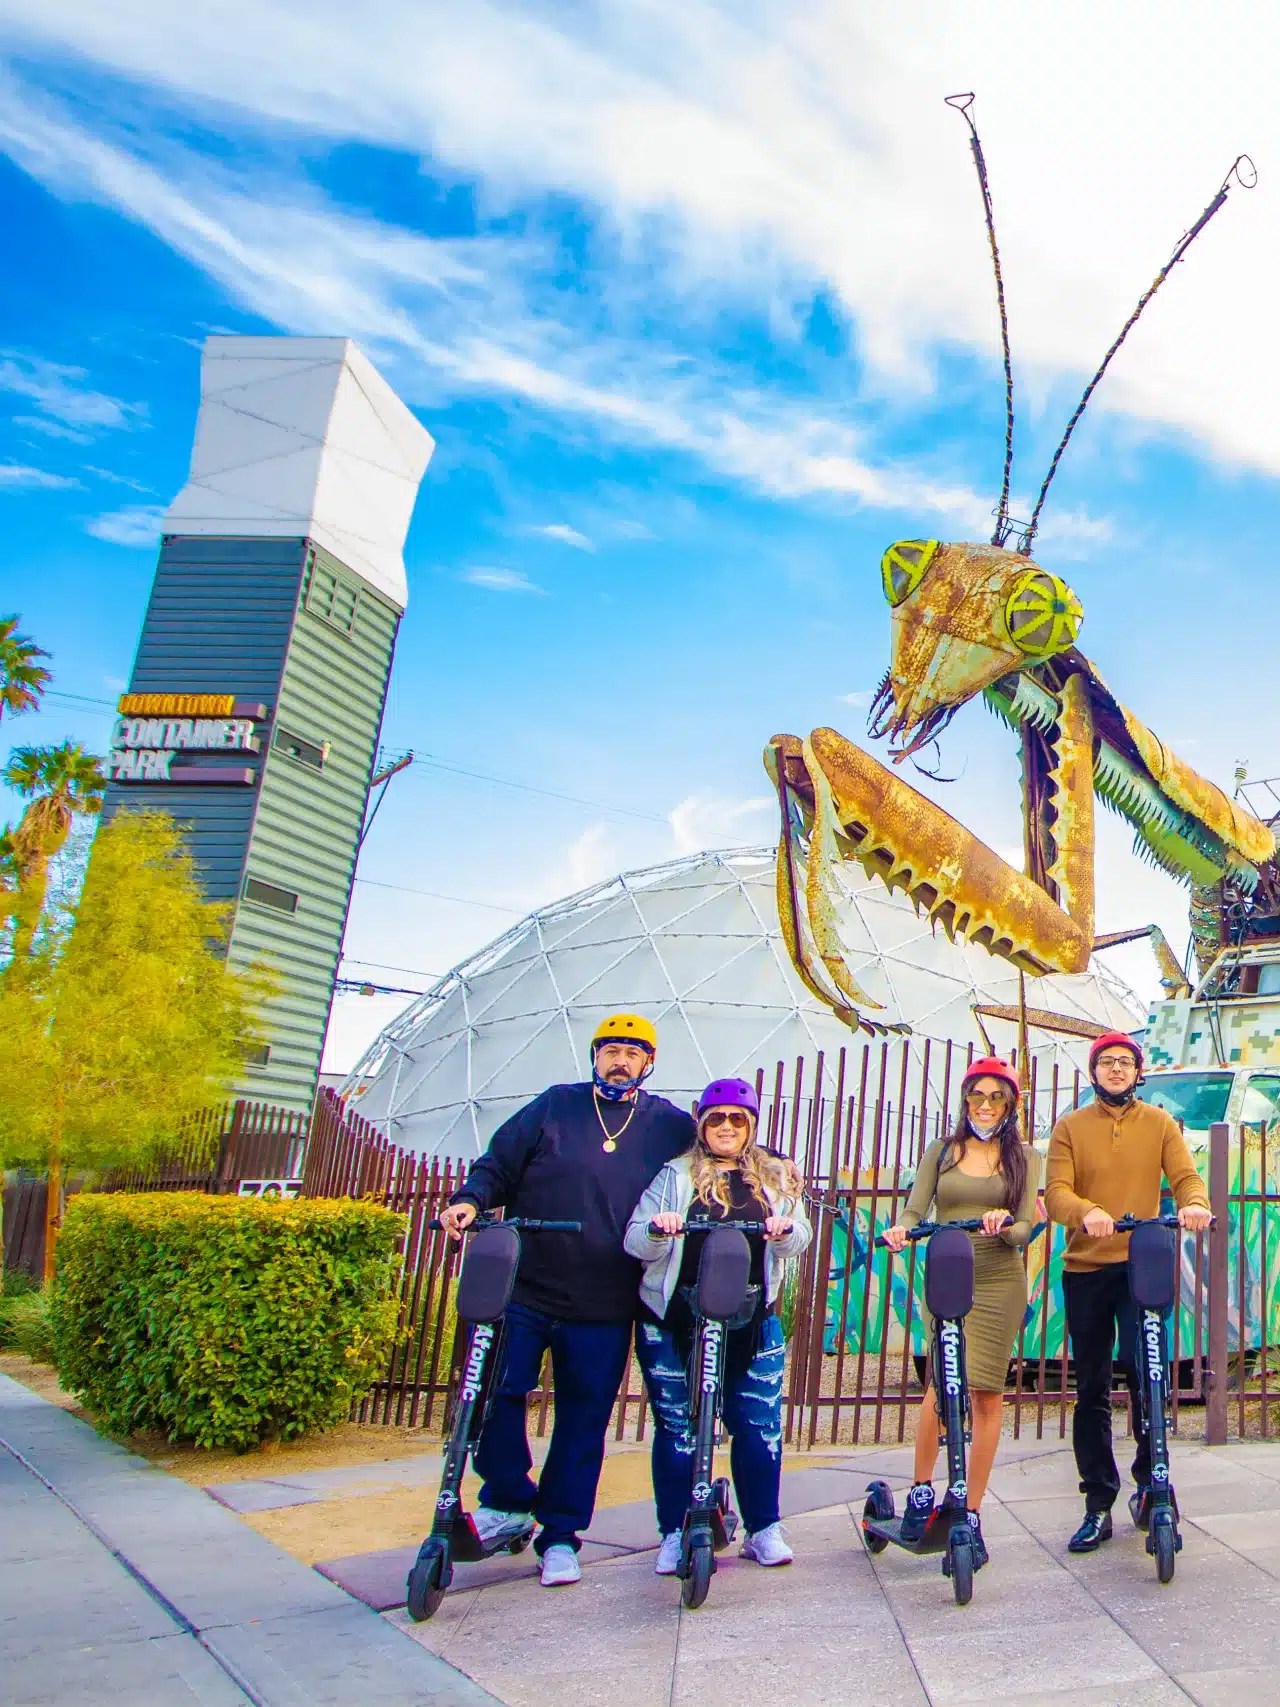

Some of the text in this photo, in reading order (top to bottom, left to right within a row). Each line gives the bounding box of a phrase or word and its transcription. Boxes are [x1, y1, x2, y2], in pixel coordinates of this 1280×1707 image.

[110, 717, 256, 750] CONTAINER
[119, 693, 235, 717] DOWNTOWN
[105, 750, 177, 780] PARK
[462, 1324, 494, 1401] Atomic
[704, 1318, 722, 1393] Atomic
[941, 1320, 961, 1395] Atomic
[1143, 1309, 1163, 1382] Atomic
